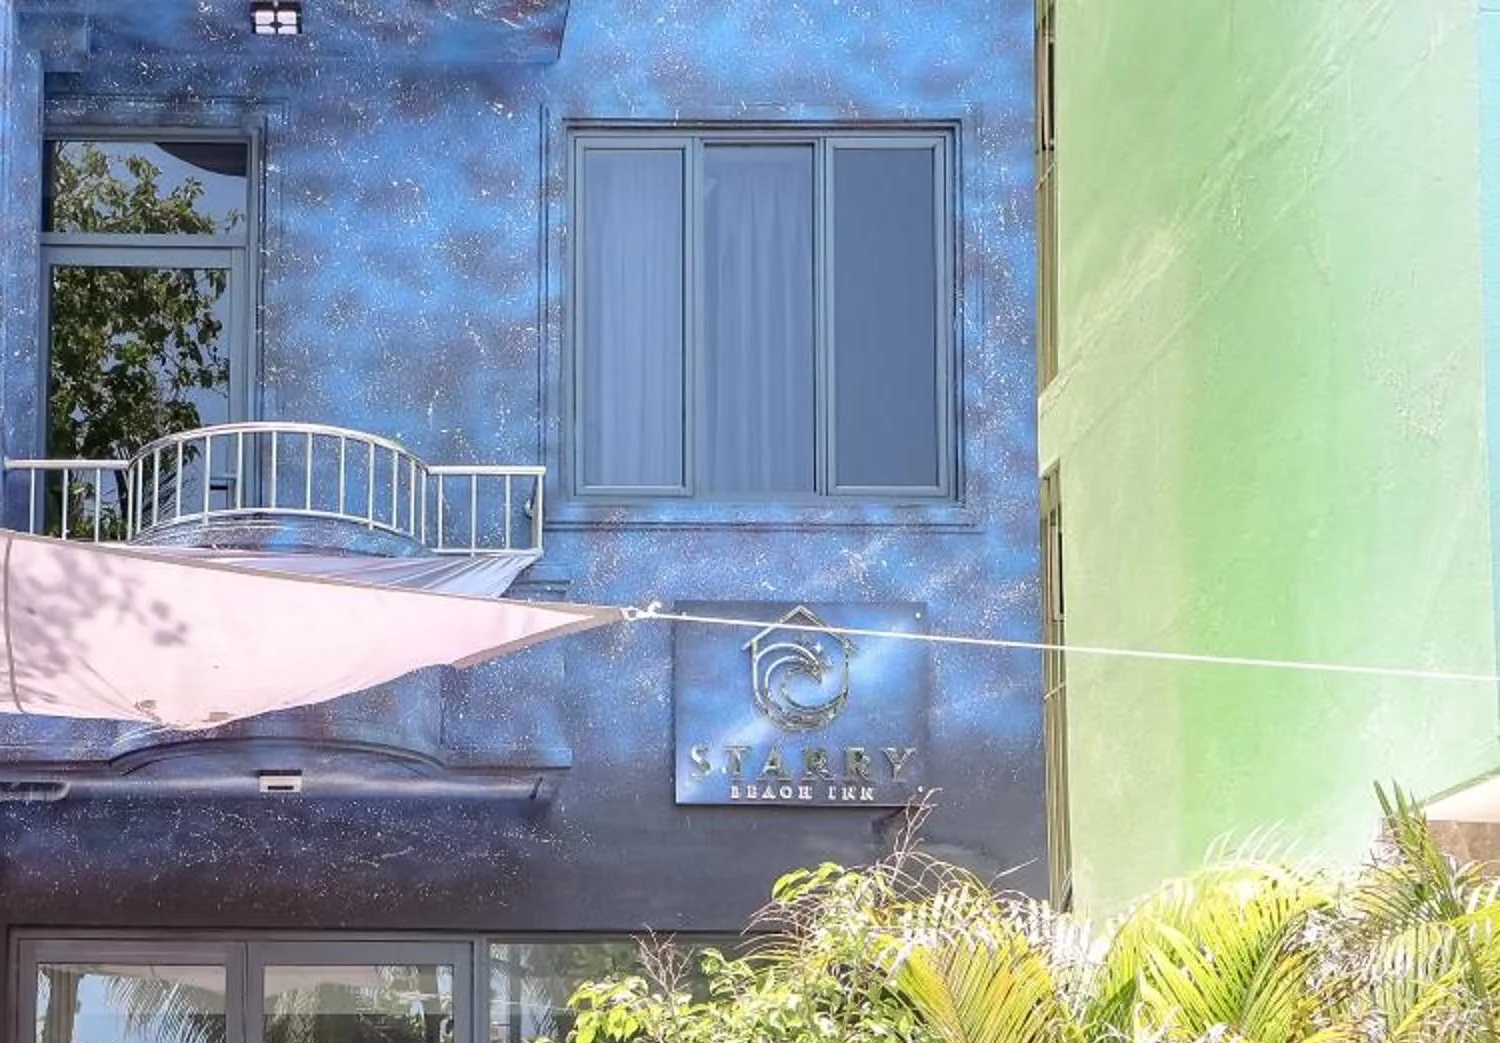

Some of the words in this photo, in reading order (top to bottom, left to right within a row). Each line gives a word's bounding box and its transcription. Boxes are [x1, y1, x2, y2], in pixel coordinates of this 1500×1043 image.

[690, 744, 917, 782] STARRY
[730, 785, 813, 800] BEACH
[828, 785, 875, 801] INN
